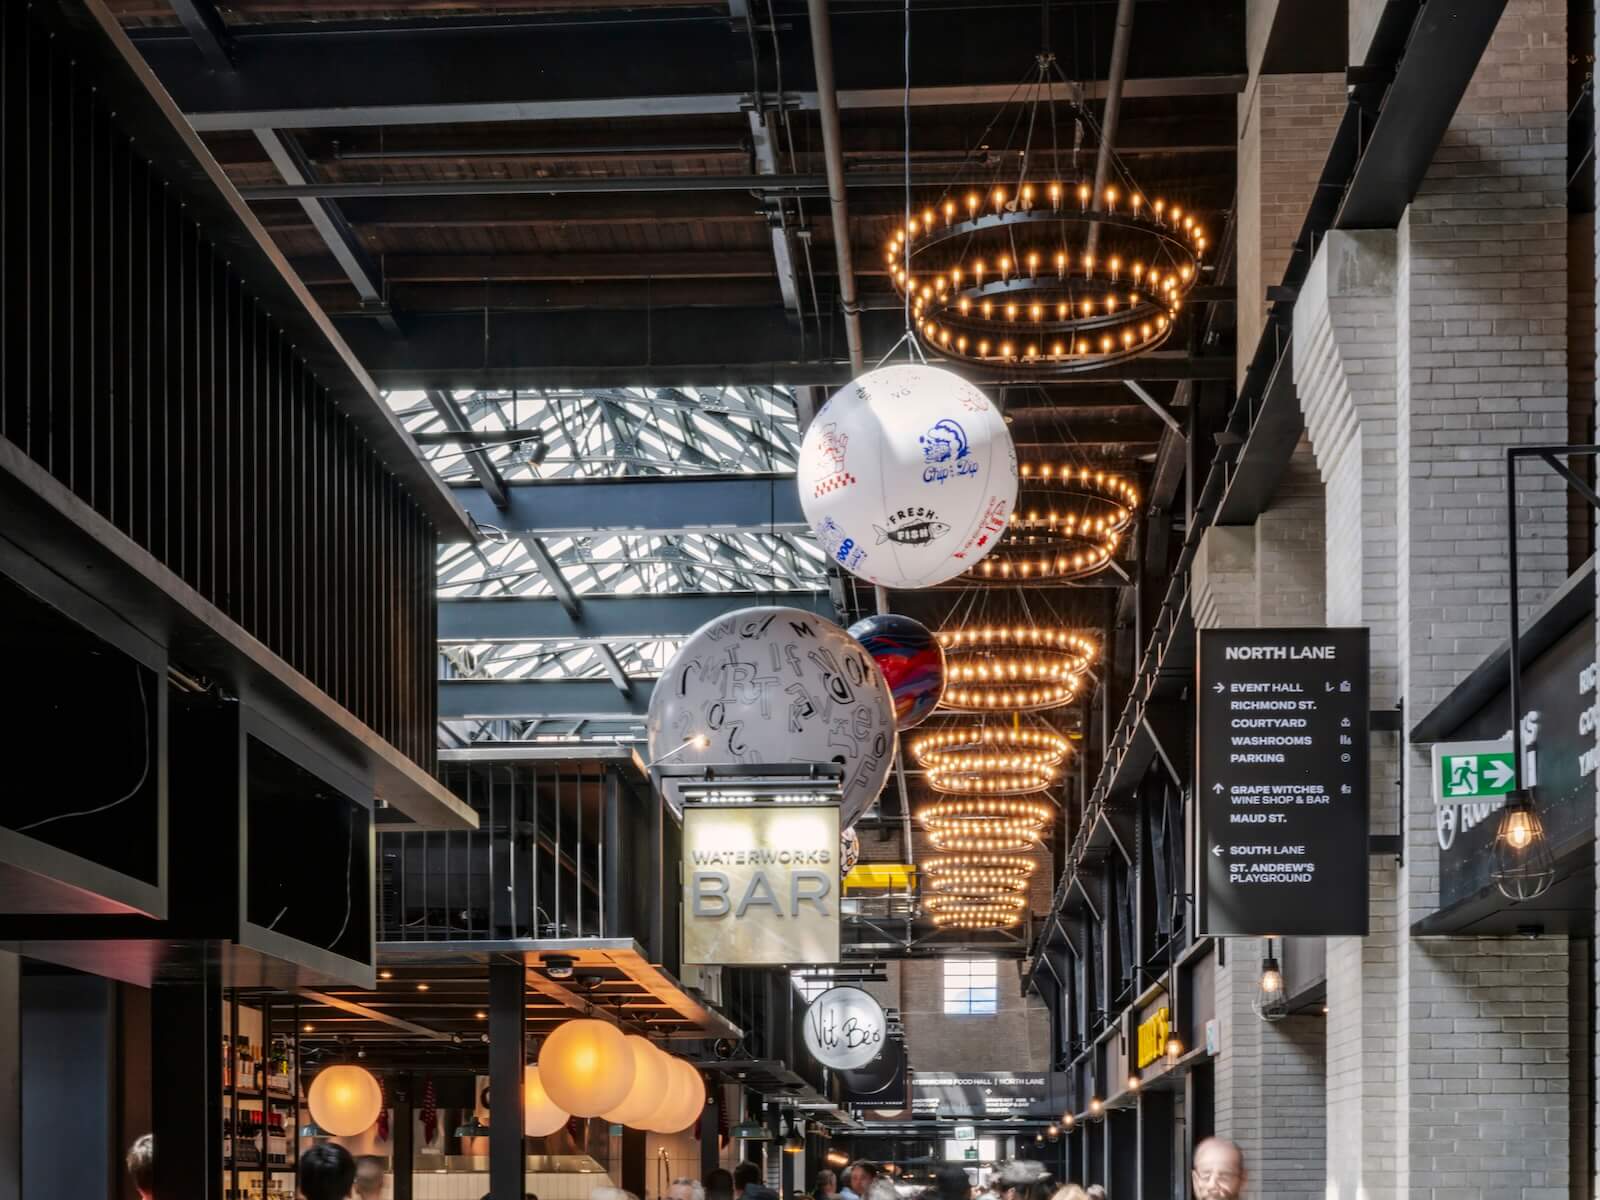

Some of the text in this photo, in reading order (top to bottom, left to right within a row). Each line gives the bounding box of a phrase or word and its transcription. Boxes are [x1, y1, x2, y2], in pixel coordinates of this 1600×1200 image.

[889, 507, 935, 525] FRESH
[896, 527, 929, 541] FISH
[1225, 646, 1336, 660] NORTH LANE
[1230, 683, 1304, 693] EVENT HALL
[1230, 701, 1317, 710] RICHMOND ST.
[1231, 718, 1307, 728] COURTYARD
[1231, 736, 1313, 746] WASHROOMS
[1230, 754, 1285, 763] PARKING
[1230, 785, 1324, 794] GRAPE WITCHES
[1231, 795, 1330, 805] WINE SHOP & BAR
[1230, 814, 1287, 823] MAUD ST.
[1230, 846, 1305, 855] SOUTH LANE
[692, 849, 831, 865] WATERWORKS
[1230, 863, 1315, 873] ST. ANDREW'S
[1230, 873, 1313, 883] PLAYGROUND
[692, 870, 831, 918] BAR
